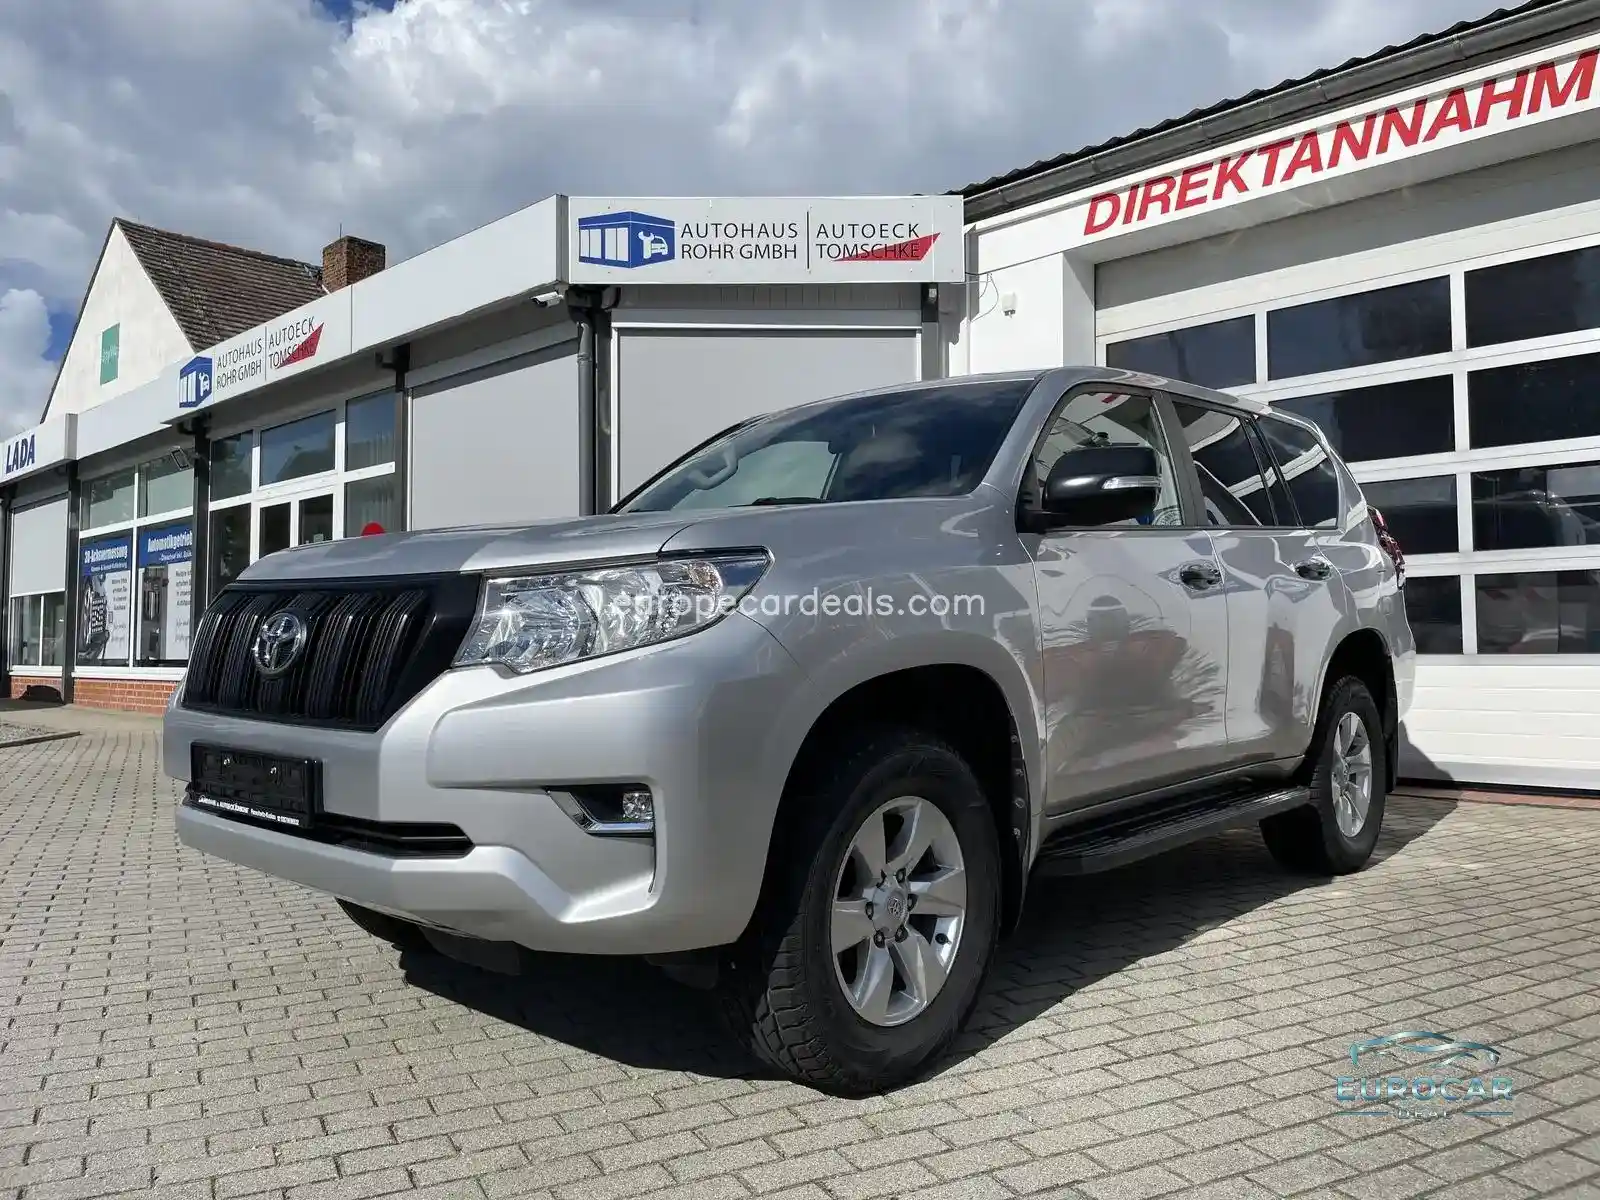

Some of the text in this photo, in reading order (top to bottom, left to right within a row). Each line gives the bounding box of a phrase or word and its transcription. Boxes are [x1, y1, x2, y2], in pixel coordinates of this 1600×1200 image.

[1083, 49, 1600, 236] DIREKTANNAHM
[681, 222, 798, 239] AUTOHAUS
[815, 223, 920, 239] AUTOECK
[681, 243, 797, 260] ROHR GMBH
[815, 243, 920, 259] TOMSCHKE
[268, 316, 315, 349] AUTOECK
[216, 338, 262, 370] AUTOHAUS
[216, 359, 262, 390] ROHR GMBH
[6, 434, 35, 474] LADA
